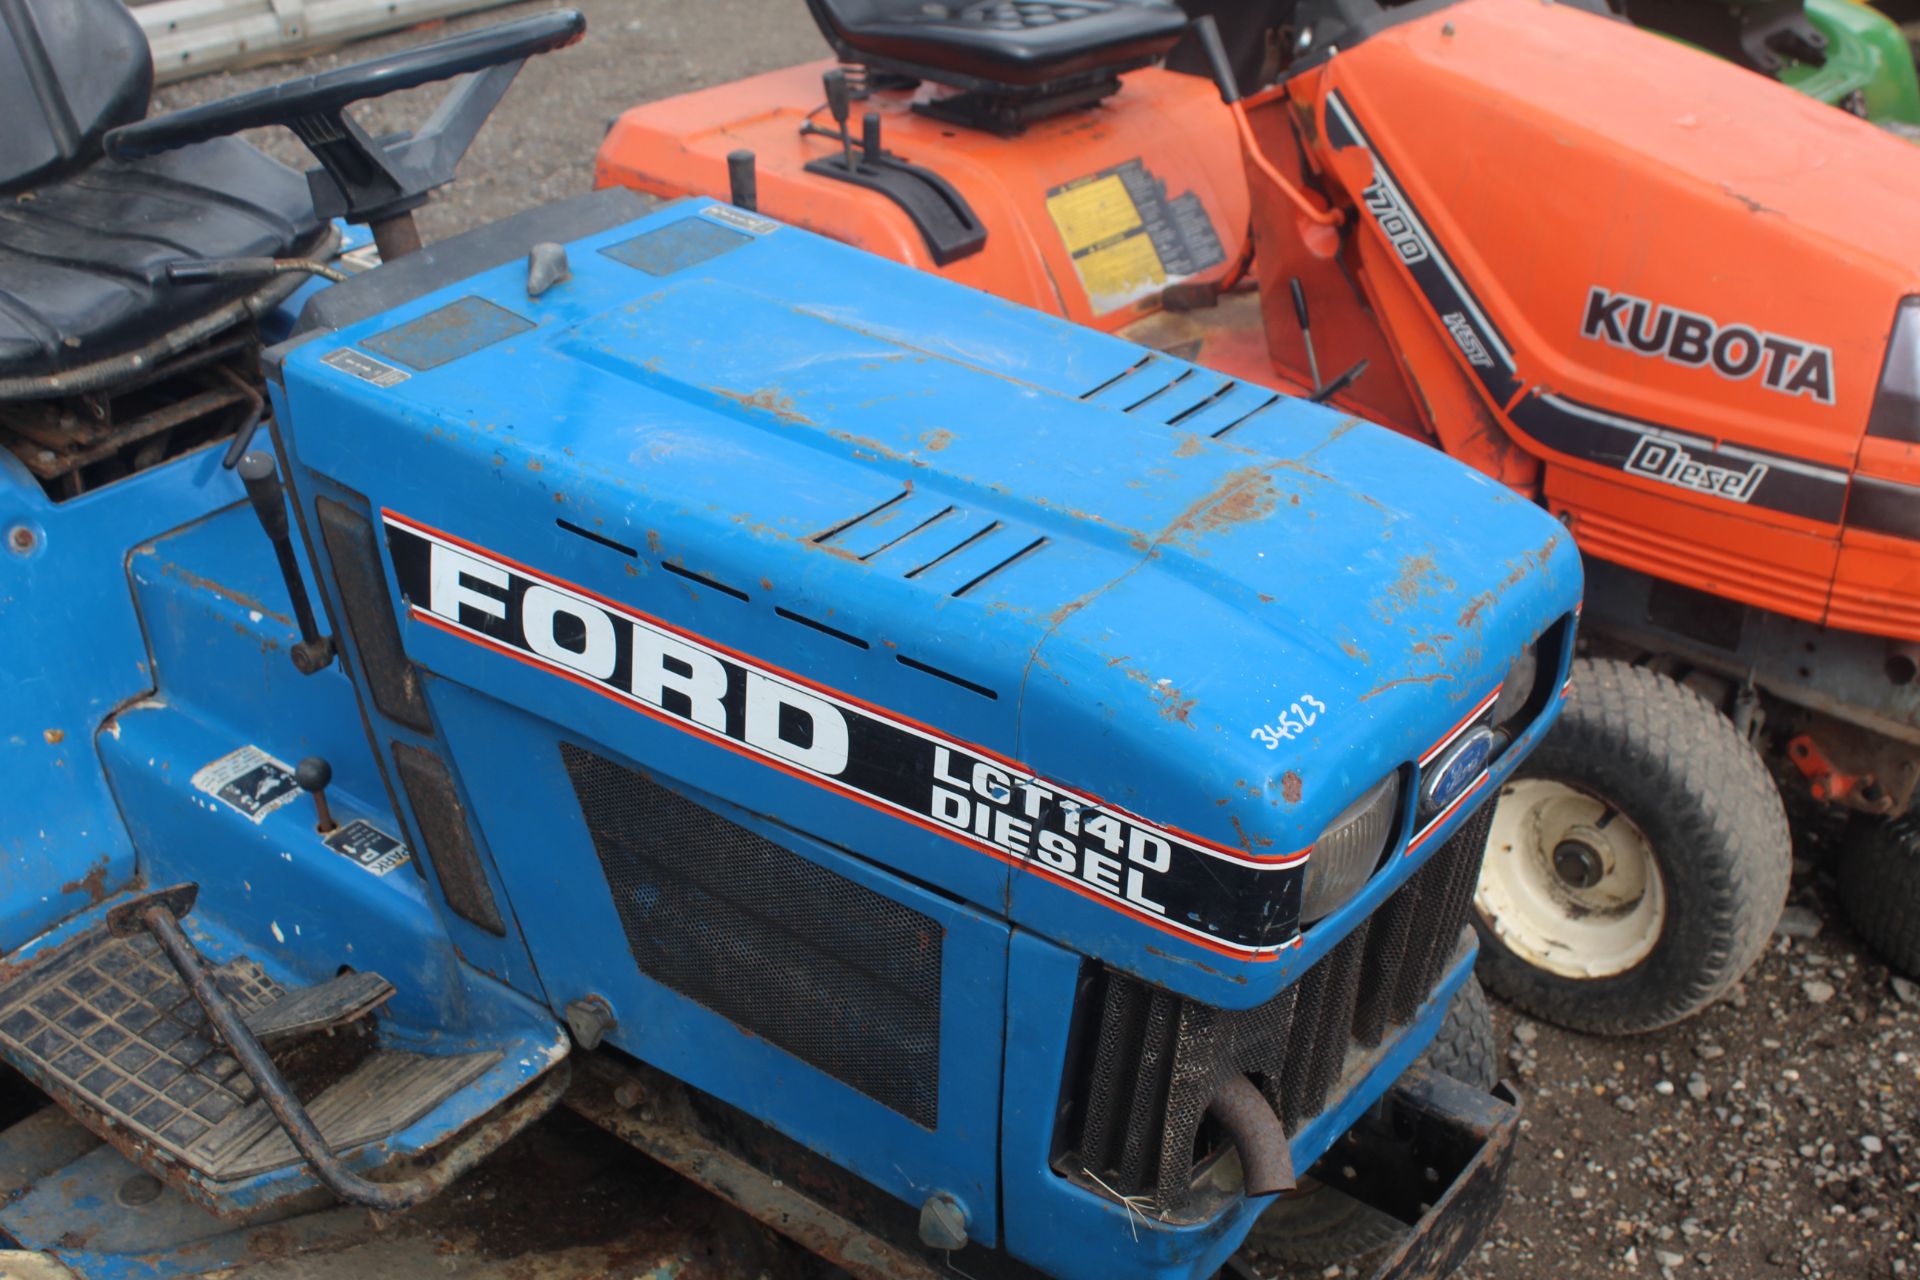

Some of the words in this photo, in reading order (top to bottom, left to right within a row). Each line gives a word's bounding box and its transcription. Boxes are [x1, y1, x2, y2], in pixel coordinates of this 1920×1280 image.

[1581, 285, 1837, 406] KUBOTA
[1624, 434, 1767, 503] Diesel
[430, 542, 850, 776] FORD
[1250, 694, 1326, 750] 34523
[371, 844, 411, 873] PARK
[931, 784, 1166, 915] DIESEL
[933, 745, 1172, 874] LGT14D
